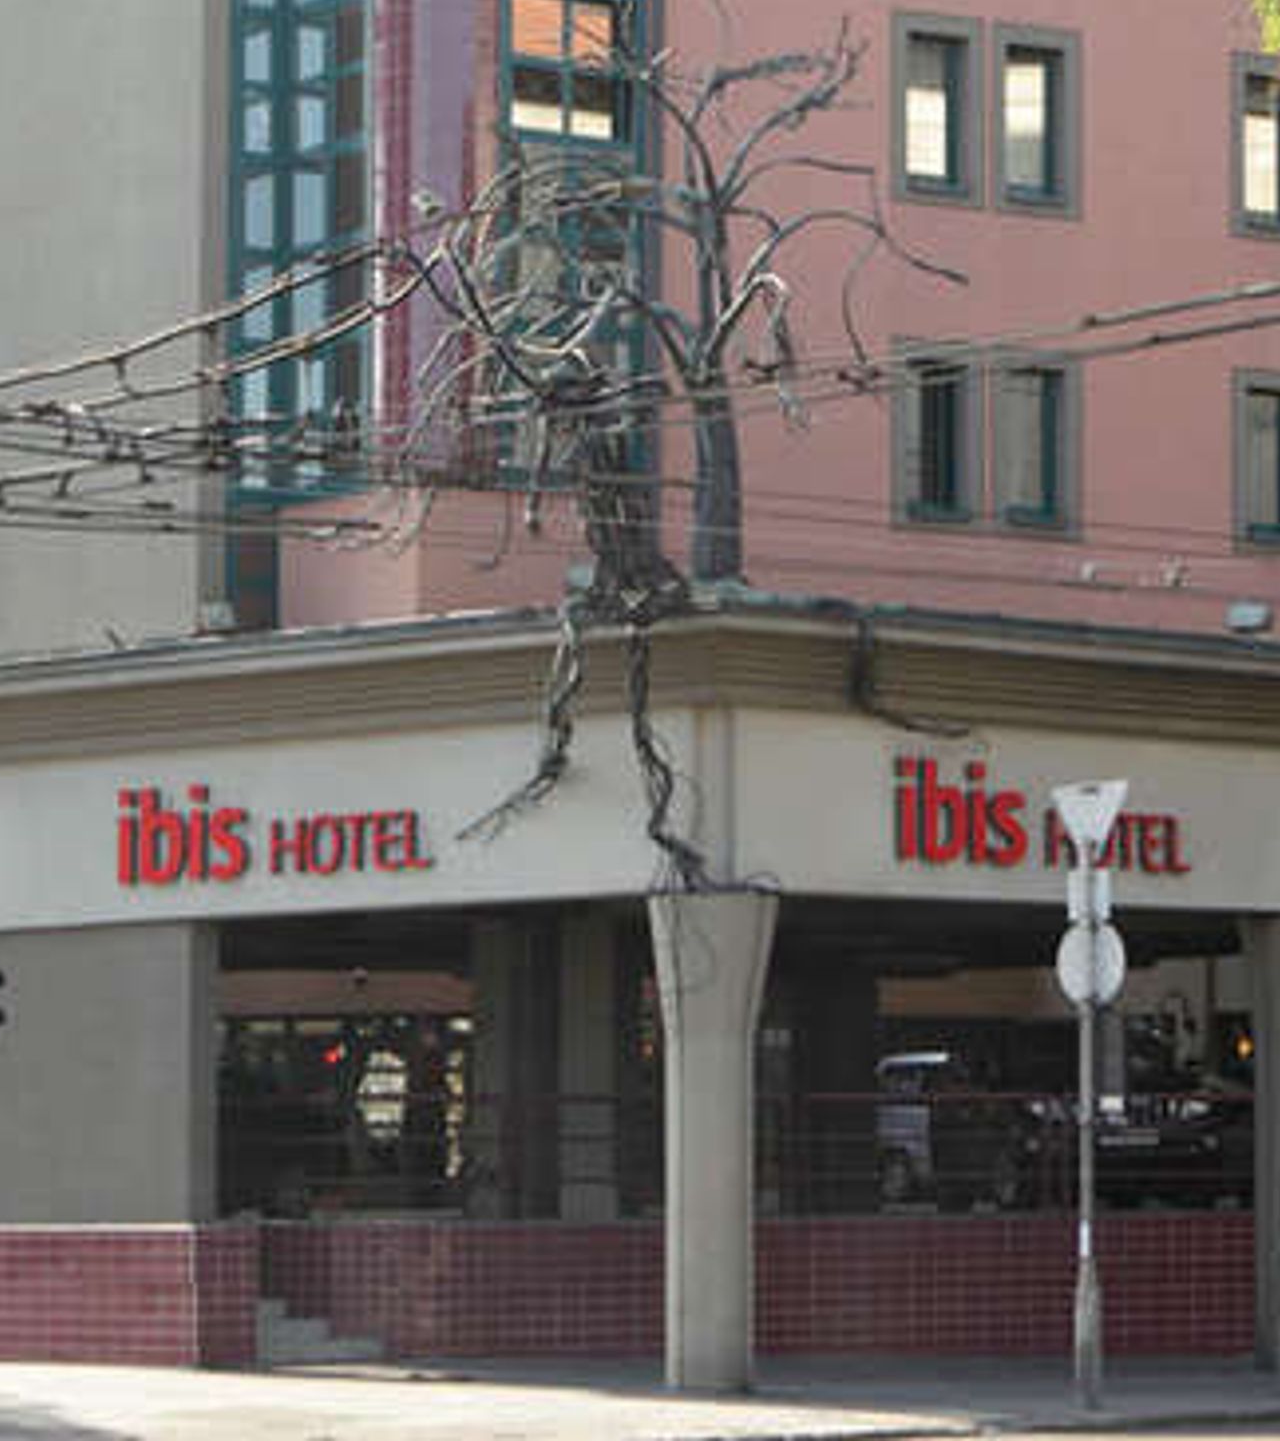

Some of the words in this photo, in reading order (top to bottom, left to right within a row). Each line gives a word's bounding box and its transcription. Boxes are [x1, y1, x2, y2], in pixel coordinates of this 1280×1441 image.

[117, 783, 250, 886] ibis
[270, 808, 436, 875] HOTEL
[894, 755, 1029, 867] ibis
